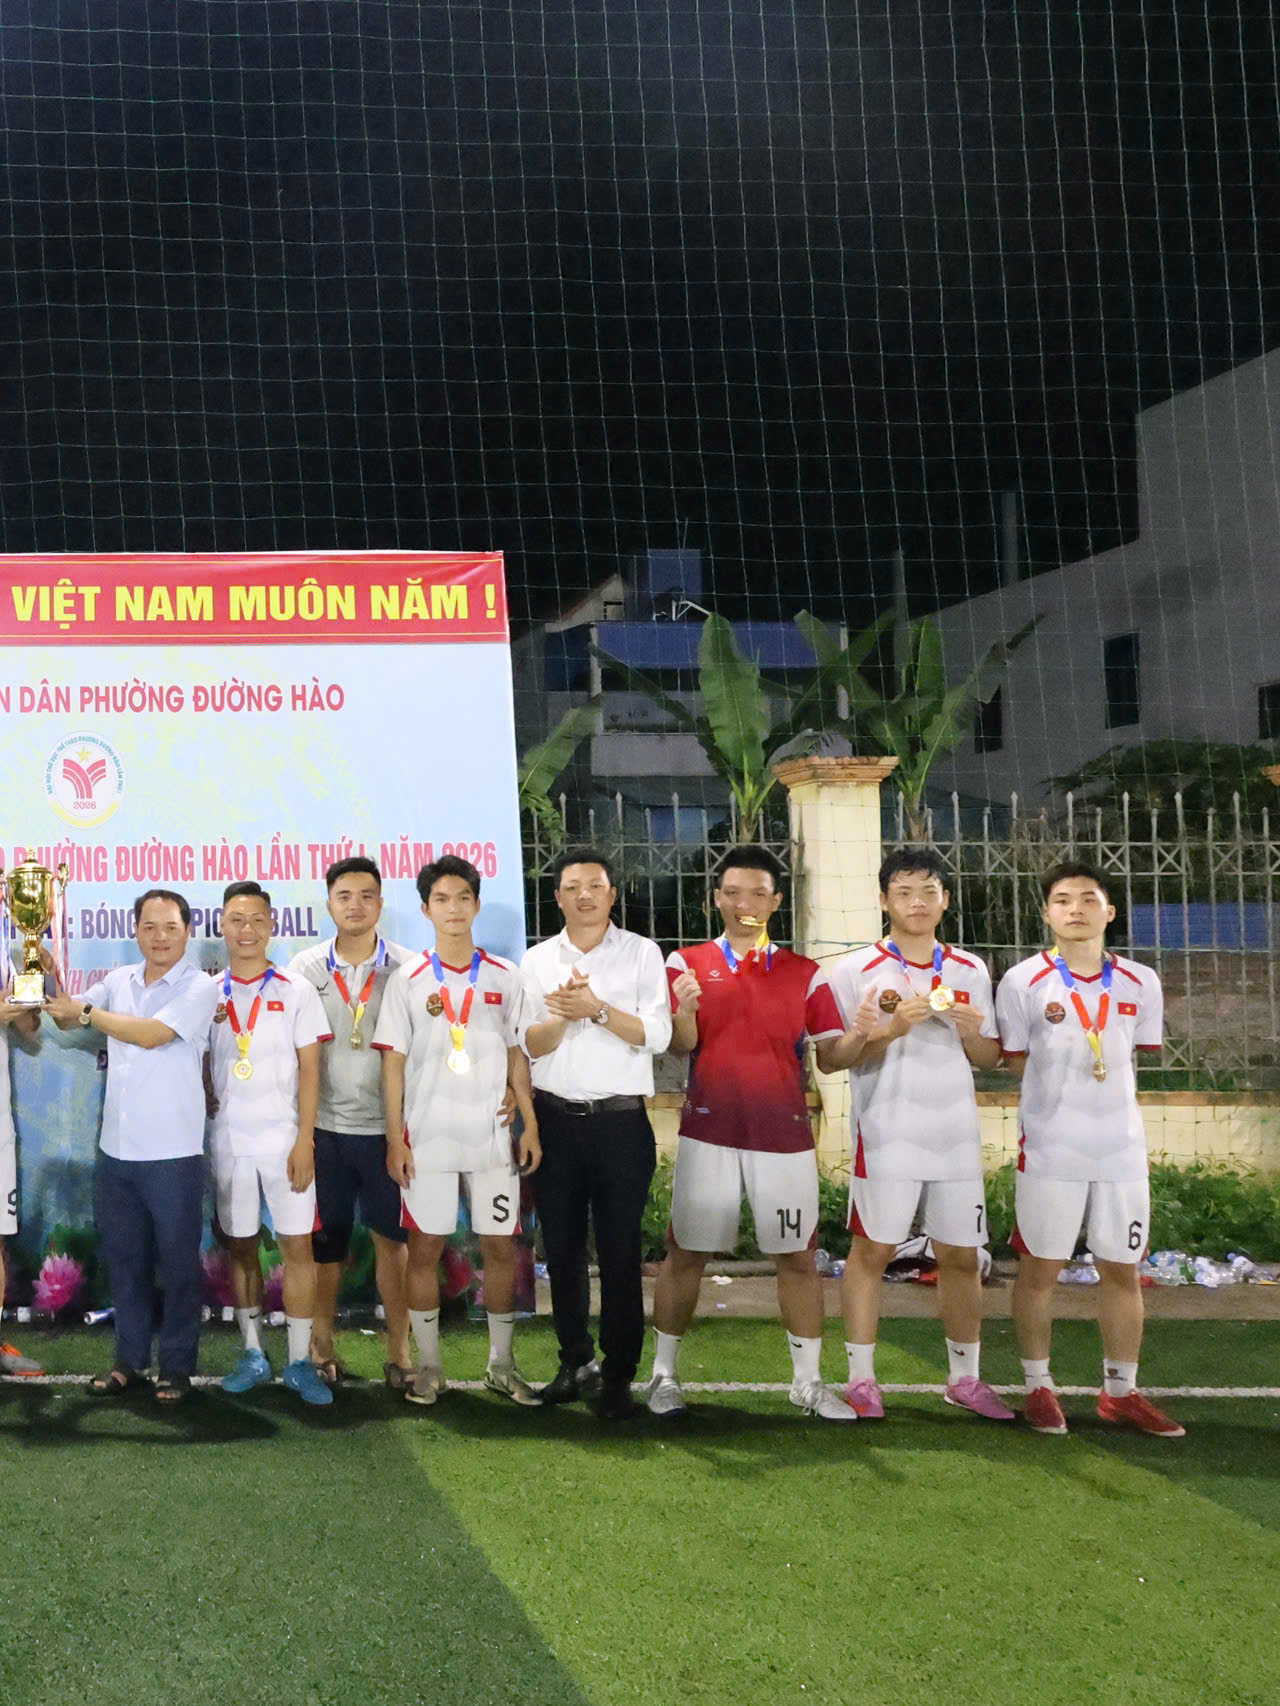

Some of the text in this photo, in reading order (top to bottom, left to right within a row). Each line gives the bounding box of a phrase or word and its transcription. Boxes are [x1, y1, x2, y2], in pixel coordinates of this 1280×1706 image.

[11, 578, 101, 629] VIỆT
[115, 585, 214, 621] NAM
[229, 577, 356, 621] MUÔN
[371, 577, 469, 620] NĂM
[19, 677, 71, 713] DÂN
[79, 677, 185, 713] PHƯỜNG
[192, 677, 283, 712] ĐƯỜNG
[291, 676, 346, 711] HÀO
[73, 800, 97, 810] 2026
[115, 837, 194, 882] ĐƯỜNG
[203, 837, 248, 881] HÀO
[256, 832, 300, 880] LẦN
[777, 1208, 801, 1238] 14
[1128, 1220, 1142, 1250] 6
